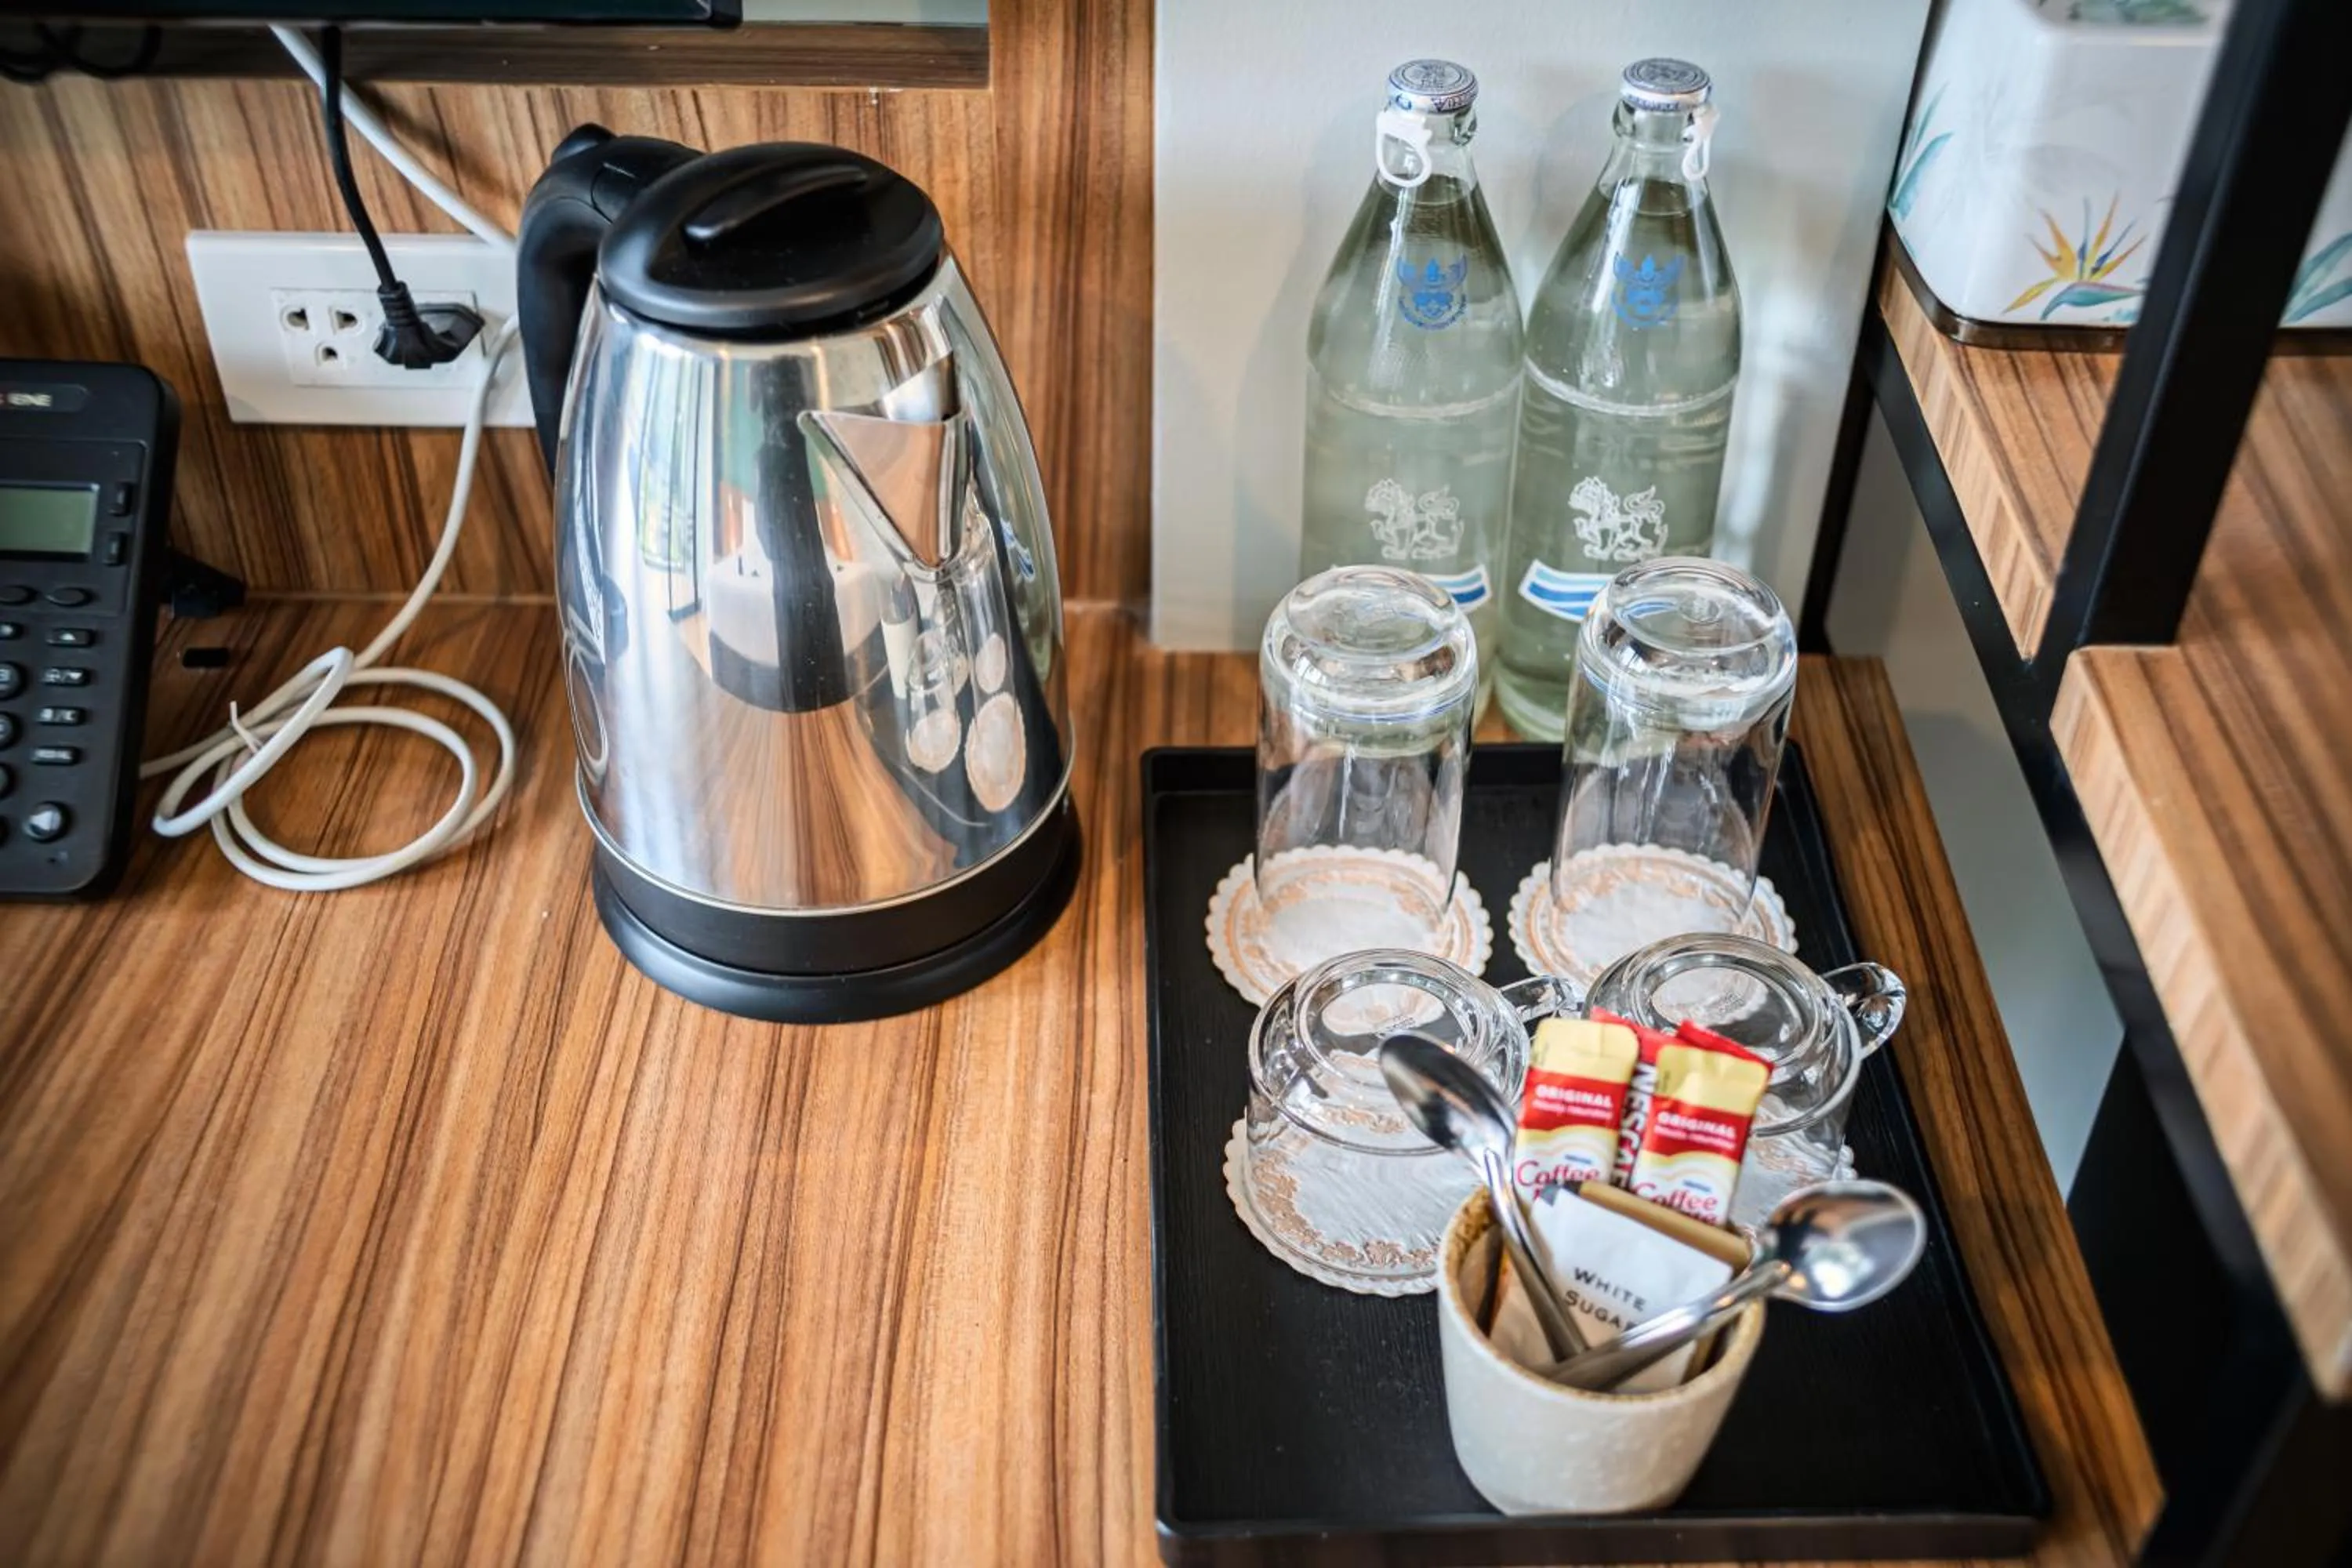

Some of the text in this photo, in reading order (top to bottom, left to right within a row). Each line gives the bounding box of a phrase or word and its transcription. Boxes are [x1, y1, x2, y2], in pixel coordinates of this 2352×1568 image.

[1534, 1083, 1613, 1109] ORIGINAL
[1609, 1062, 1657, 1190] NESCAF
[1657, 1111, 1737, 1138] ORIGINAL
[1573, 1266, 1647, 1312] WHITE
